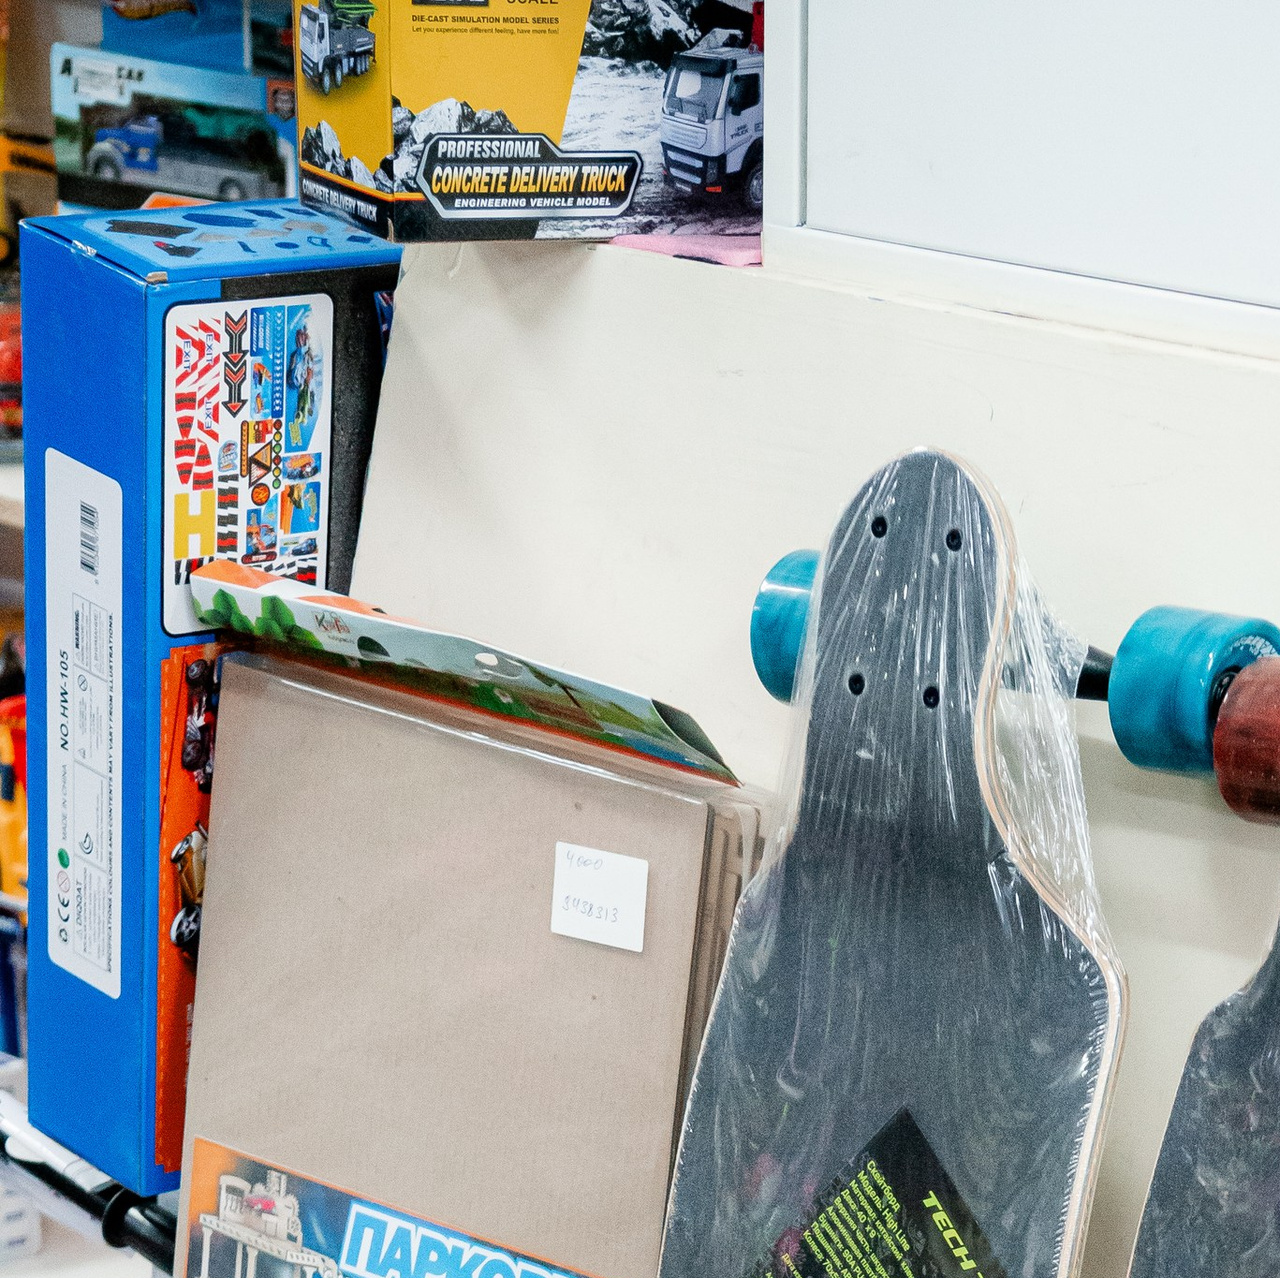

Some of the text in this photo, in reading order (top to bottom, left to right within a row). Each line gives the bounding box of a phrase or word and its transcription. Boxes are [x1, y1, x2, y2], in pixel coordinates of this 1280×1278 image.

[411, 15, 449, 23] DIE-CAST
[451, 15, 501, 24] SIMULATION
[502, 16, 530, 24] MODEL
[422, 27, 434, 35] you
[435, 26, 468, 35] experience
[468, 26, 494, 34] different
[516, 27, 531, 35] have
[437, 140, 542, 159] PROFESSIONAL
[431, 165, 628, 194] CONCRETE DELIVERY TRUCK
[302, 178, 330, 204] CONCRETE
[329, 189, 357, 215] DELIVERY
[454, 197, 612, 208] ENGINEERING VEHICLE MODEL
[183, 340, 191, 371] EXIT
[205, 333, 214, 364] EXIT
[204, 400, 213, 430] EXIT
[59, 649, 69, 751] NO.HW-105
[61, 796, 68, 809] IN
[868, 1160, 900, 1212] Скейтборд
[858, 1171, 910, 1251] Модель: High Line
[923, 1191, 977, 1270] TECH
